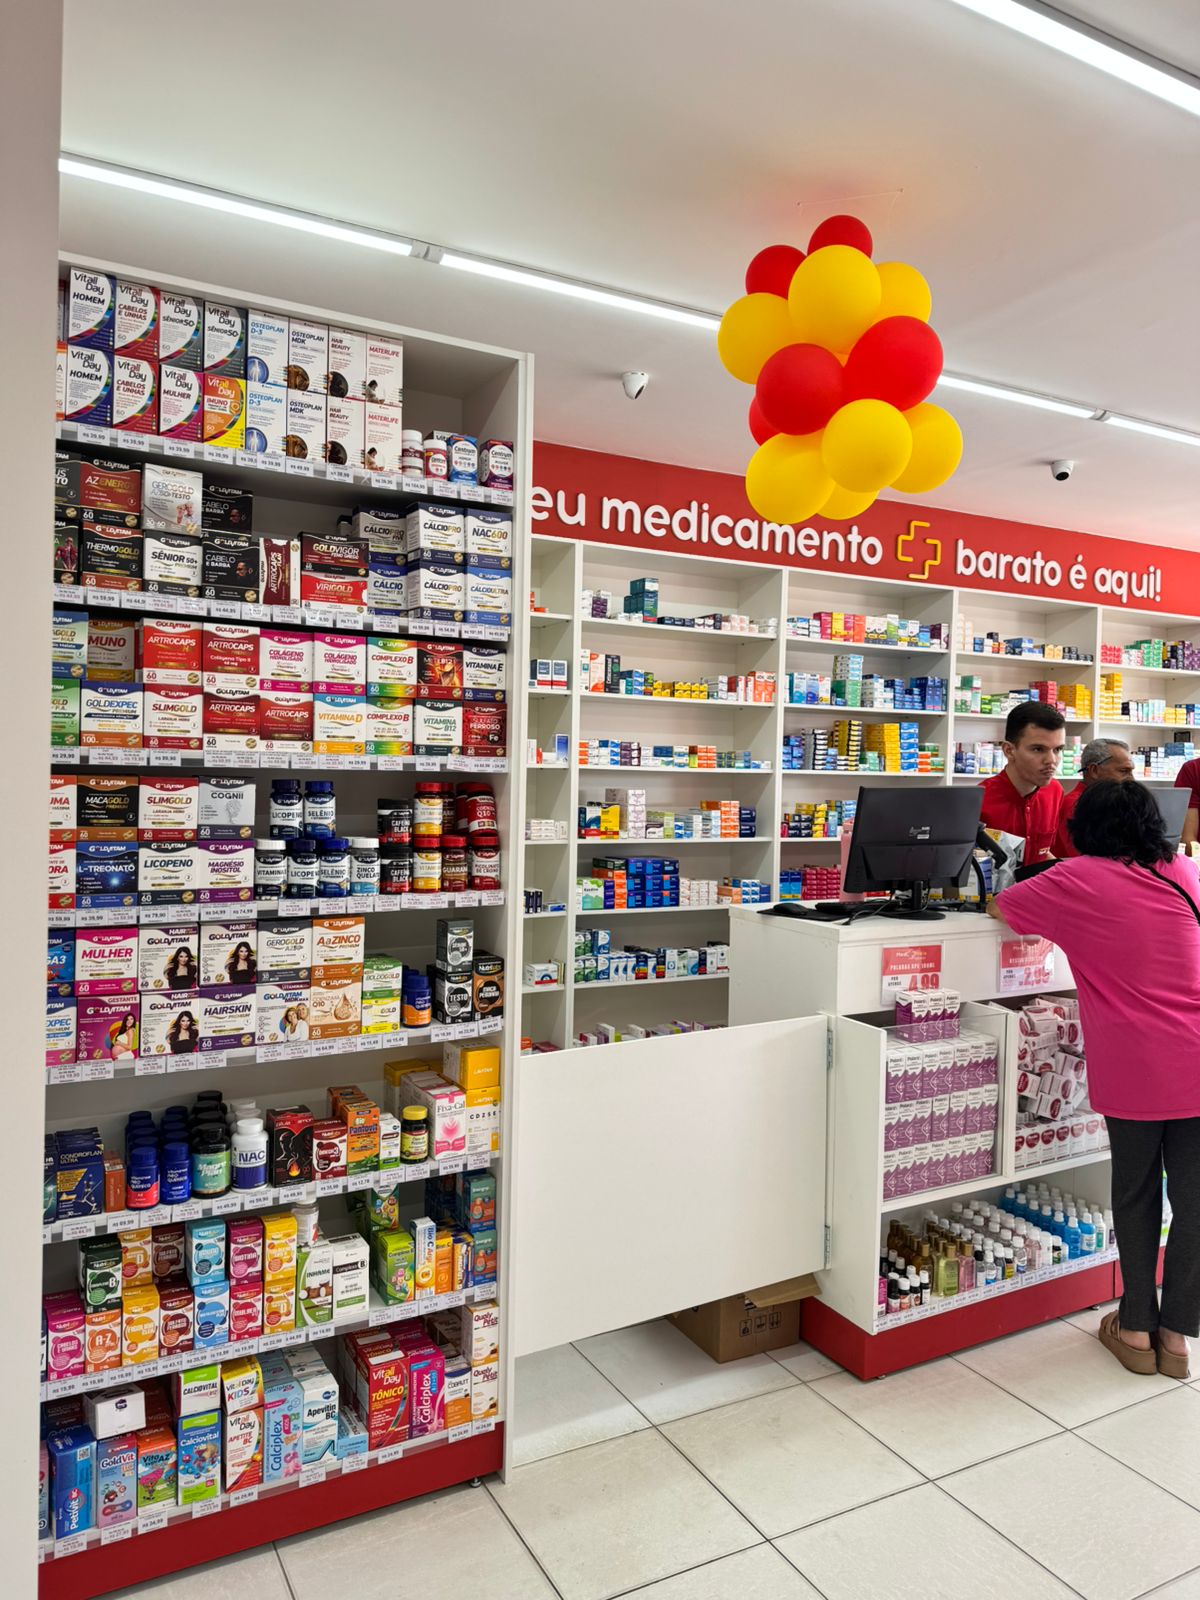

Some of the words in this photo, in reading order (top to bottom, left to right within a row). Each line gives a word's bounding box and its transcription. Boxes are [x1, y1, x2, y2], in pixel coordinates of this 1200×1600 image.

[74, 272, 98, 285] Vitall
[85, 282, 104, 296] Day
[120, 285, 143, 297] Vitall
[72, 292, 105, 306] HOMEM
[130, 294, 149, 307] Day
[163, 296, 186, 307] Vitall
[118, 303, 148, 315] CABELOS
[174, 305, 192, 317] Day
[208, 307, 230, 318] Vitall
[123, 310, 147, 321] UNHAS
[219, 316, 235, 327] Day
[250, 322, 284, 334] OSTEOPLAN
[292, 331, 324, 342] OSTEOPLAN
[70, 350, 95, 363] Vitall
[369, 346, 400, 358] MATERLIFE
[83, 360, 102, 373] Day
[118, 361, 141, 372] Vitall
[69, 370, 102, 383] HOMEM
[129, 370, 147, 383] Day
[164, 370, 187, 381] Vitall
[116, 379, 146, 391] CABELOS
[175, 379, 193, 391] Day
[207, 377, 230, 388] Vitall
[122, 386, 145, 396] UNHAS
[163, 389, 192, 400] MULHER
[218, 386, 235, 398] Day
[248, 393, 283, 404] OSTEOPLAN
[290, 401, 322, 412] OSTEOPLAN
[368, 413, 399, 425] MATERLIFE
[472, 528, 508, 540] NAC600
[602, 497, 883, 565] medicamento
[956, 538, 1062, 587] barato
[1069, 554, 1087, 590] é
[1094, 565, 1162, 603] aqui!
[151, 550, 185, 563] SÊNIOR
[205, 554, 236, 564] CABELO
[316, 582, 353, 593] VIRIGOLD
[373, 580, 403, 590] CÁLCIO
[148, 636, 196, 647] ARTROCAPS
[207, 641, 254, 651] ARTROCAPS
[269, 649, 304, 657] COLÁGENO
[324, 652, 357, 660] COLÁGENO
[371, 654, 407, 663] COMPLEXO
[407, 655, 414, 664] B
[465, 662, 497, 670] VITAMINA
[497, 663, 503, 672] E
[86, 699, 138, 708] GOLDEXPEC
[152, 703, 197, 713] SLIMGOLD
[209, 704, 256, 713] ARTROCAPS
[265, 710, 309, 719] ARTROCAPS
[356, 713, 363, 722] D
[367, 713, 402, 721] COMPLEXO
[403, 714, 410, 722] B
[85, 796, 130, 804] MACAGOLD
[146, 796, 192, 805] SLIMGOLD
[78, 864, 135, 873] L-TREONATO
[144, 859, 193, 868] LICOPENO
[266, 938, 304, 946] GEROGOLD
[82, 948, 133, 959] MULHER
[204, 1005, 252, 1016] HAIRSKIN
[436, 1101, 465, 1113] Fixa-Cal
[238, 1151, 266, 1162] NAC
[372, 1366, 396, 1380] Vitall
[383, 1374, 401, 1386] Day
[183, 1383, 218, 1395] CALCIOVITAL
[227, 1387, 250, 1402] KIDS
[372, 1386, 404, 1402] TÔNICO
[420, 1373, 431, 1423] Calciplex
[307, 1403, 336, 1417] Apevitin
[230, 1414, 250, 1427] Vitall
[325, 1412, 336, 1420] BC
[239, 1421, 256, 1431] Day
[180, 1431, 219, 1446] Calciovital
[228, 1432, 252, 1443] APETITE
[271, 1420, 282, 1471] Calciplex
